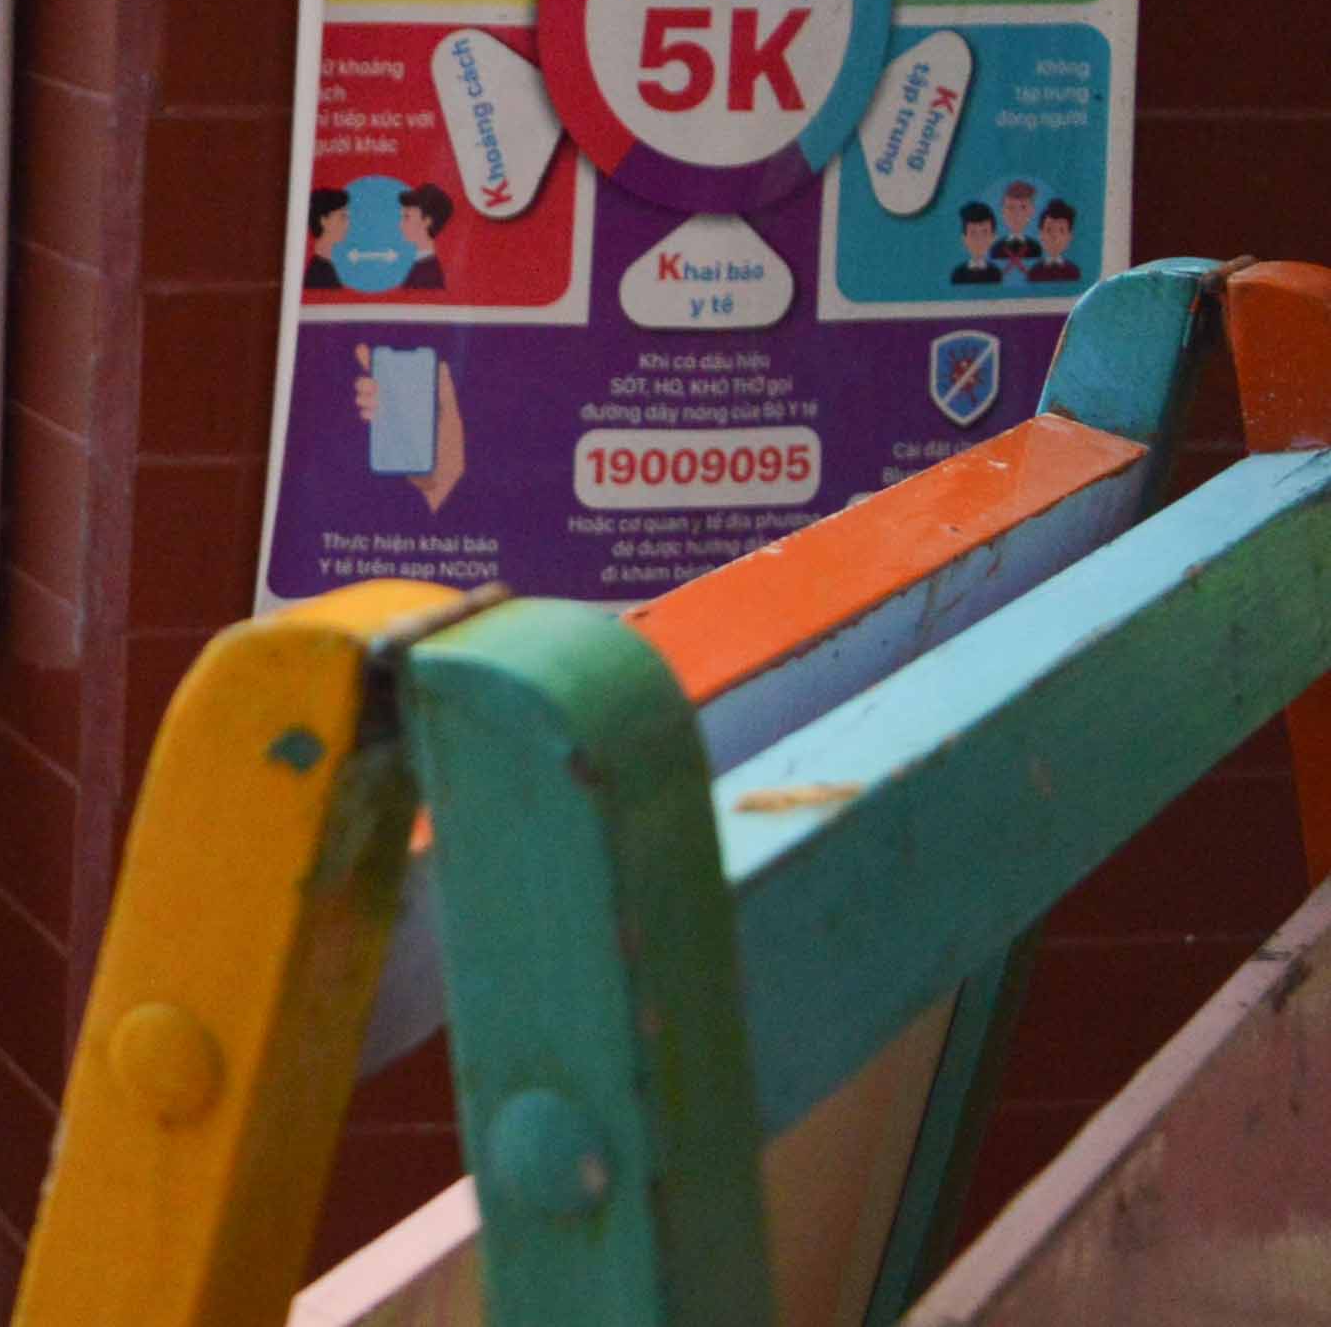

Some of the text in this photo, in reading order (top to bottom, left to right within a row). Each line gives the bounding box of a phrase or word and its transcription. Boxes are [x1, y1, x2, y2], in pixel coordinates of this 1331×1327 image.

[637, 7, 813, 113] 5K
[876, 110, 915, 176] trung
[906, 85, 959, 173] Không
[657, 252, 765, 282] Khai báo
[690, 294, 735, 318] y tế
[586, 443, 812, 487] 19009095
